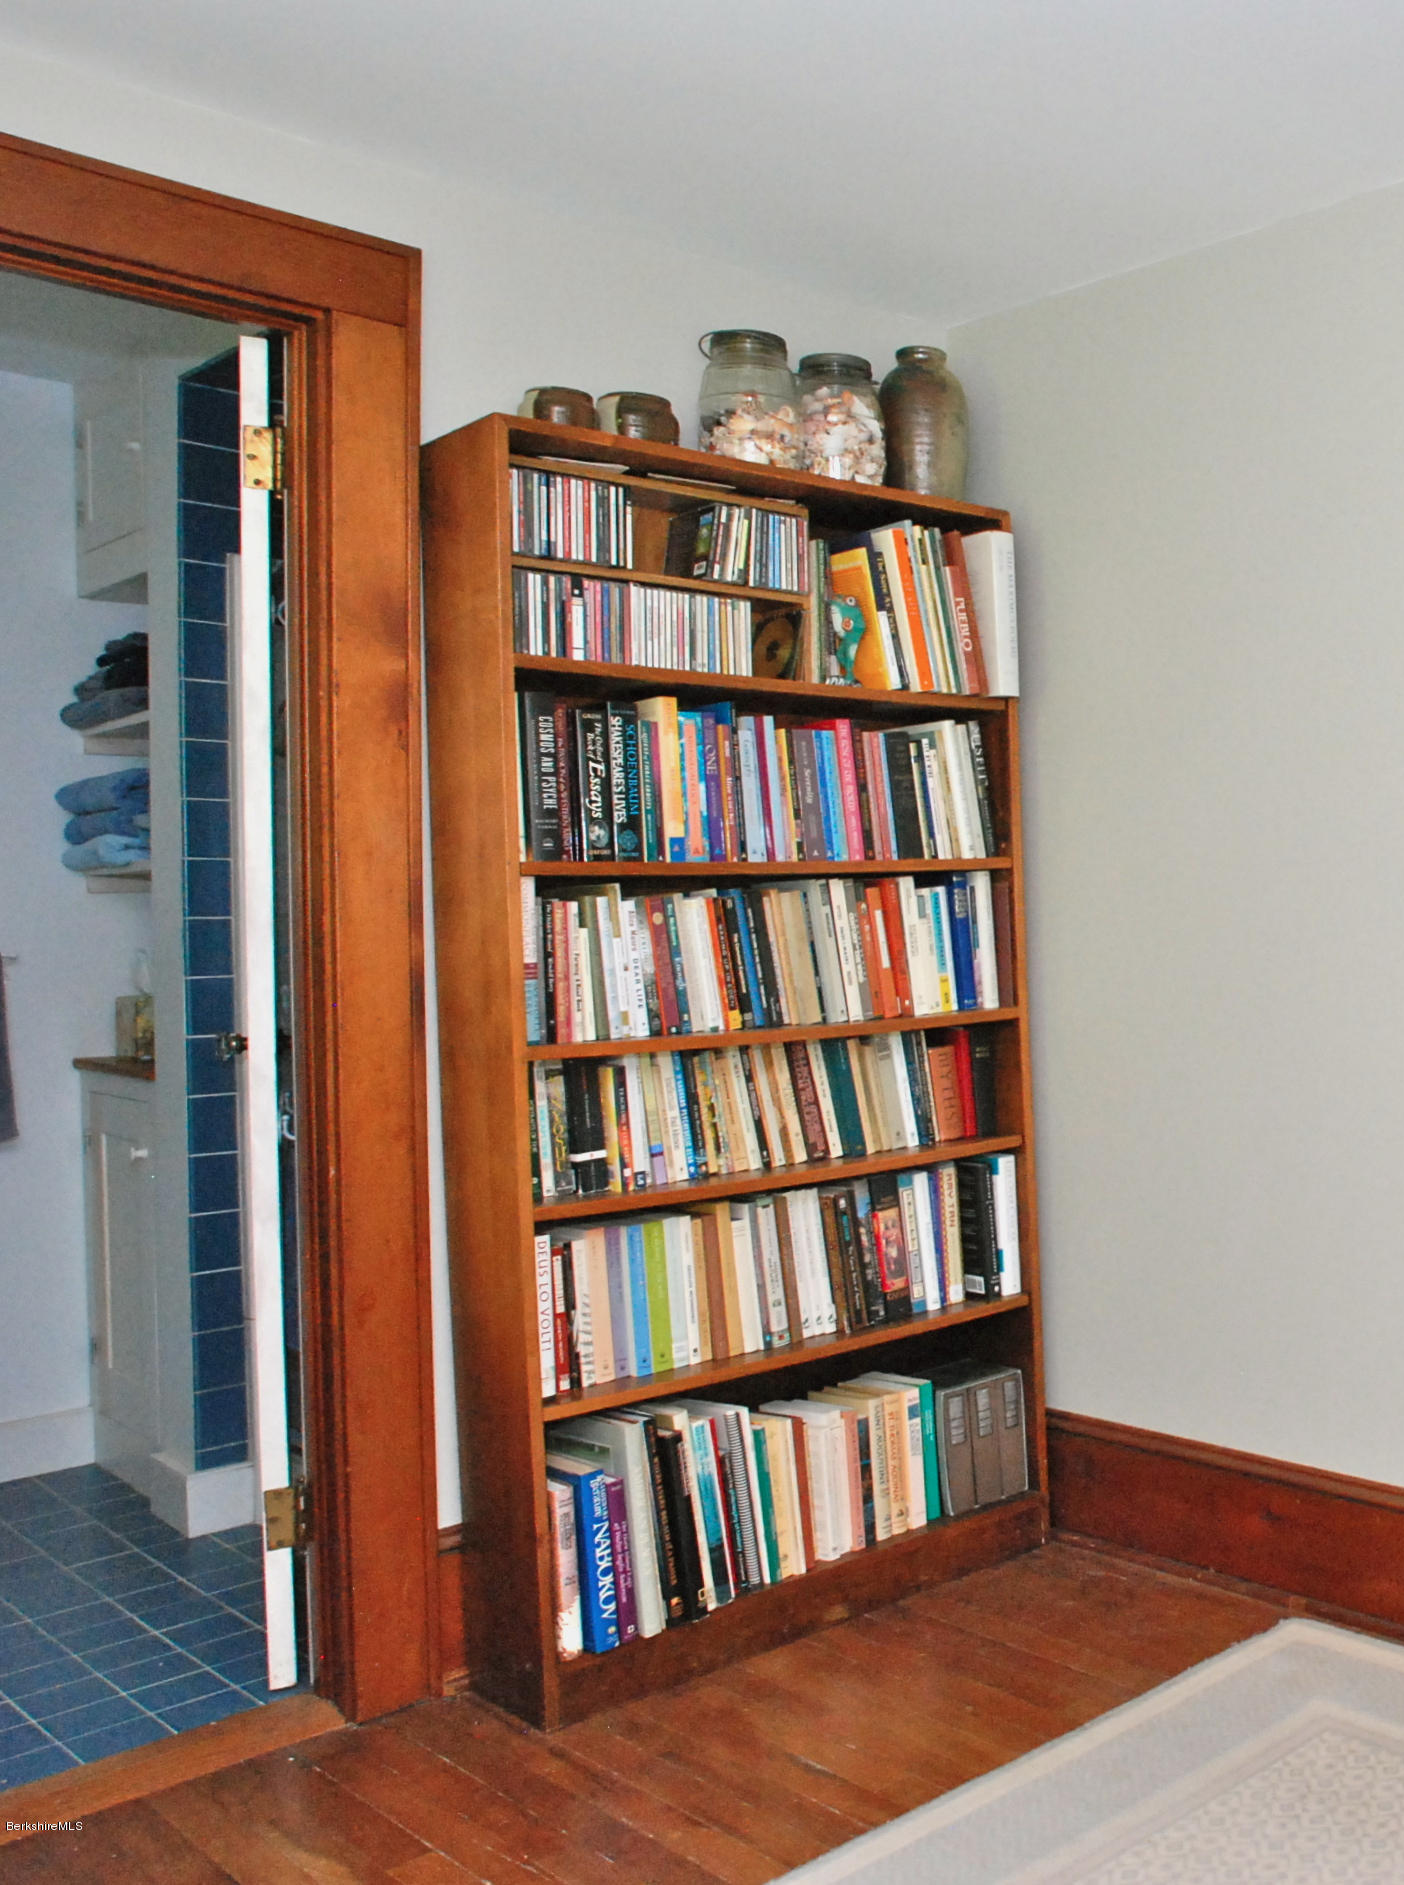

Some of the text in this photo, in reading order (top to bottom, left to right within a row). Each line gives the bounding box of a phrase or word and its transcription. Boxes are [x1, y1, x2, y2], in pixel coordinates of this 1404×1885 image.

[955, 597, 973, 652] PUEBLO
[538, 716, 555, 753] COSMOS
[585, 732, 595, 760] Book of
[594, 722, 604, 761] The Oxford
[540, 757, 555, 772] AND
[624, 724, 639, 815] SCHOENBAUM
[705, 744, 717, 775] ONE
[541, 776, 558, 809] PSYCHE
[585, 761, 606, 818] Essays
[803, 768, 815, 804] Serenity
[614, 794, 627, 823] LIVES
[632, 958, 642, 984] DEAR
[722, 958, 730, 969] UP
[725, 972, 732, 982] IN
[636, 989, 644, 1010] LIFE
[536, 1241, 552, 1352] DEUS LO VOLT!
[592, 1522, 617, 1620] NABOKOV
